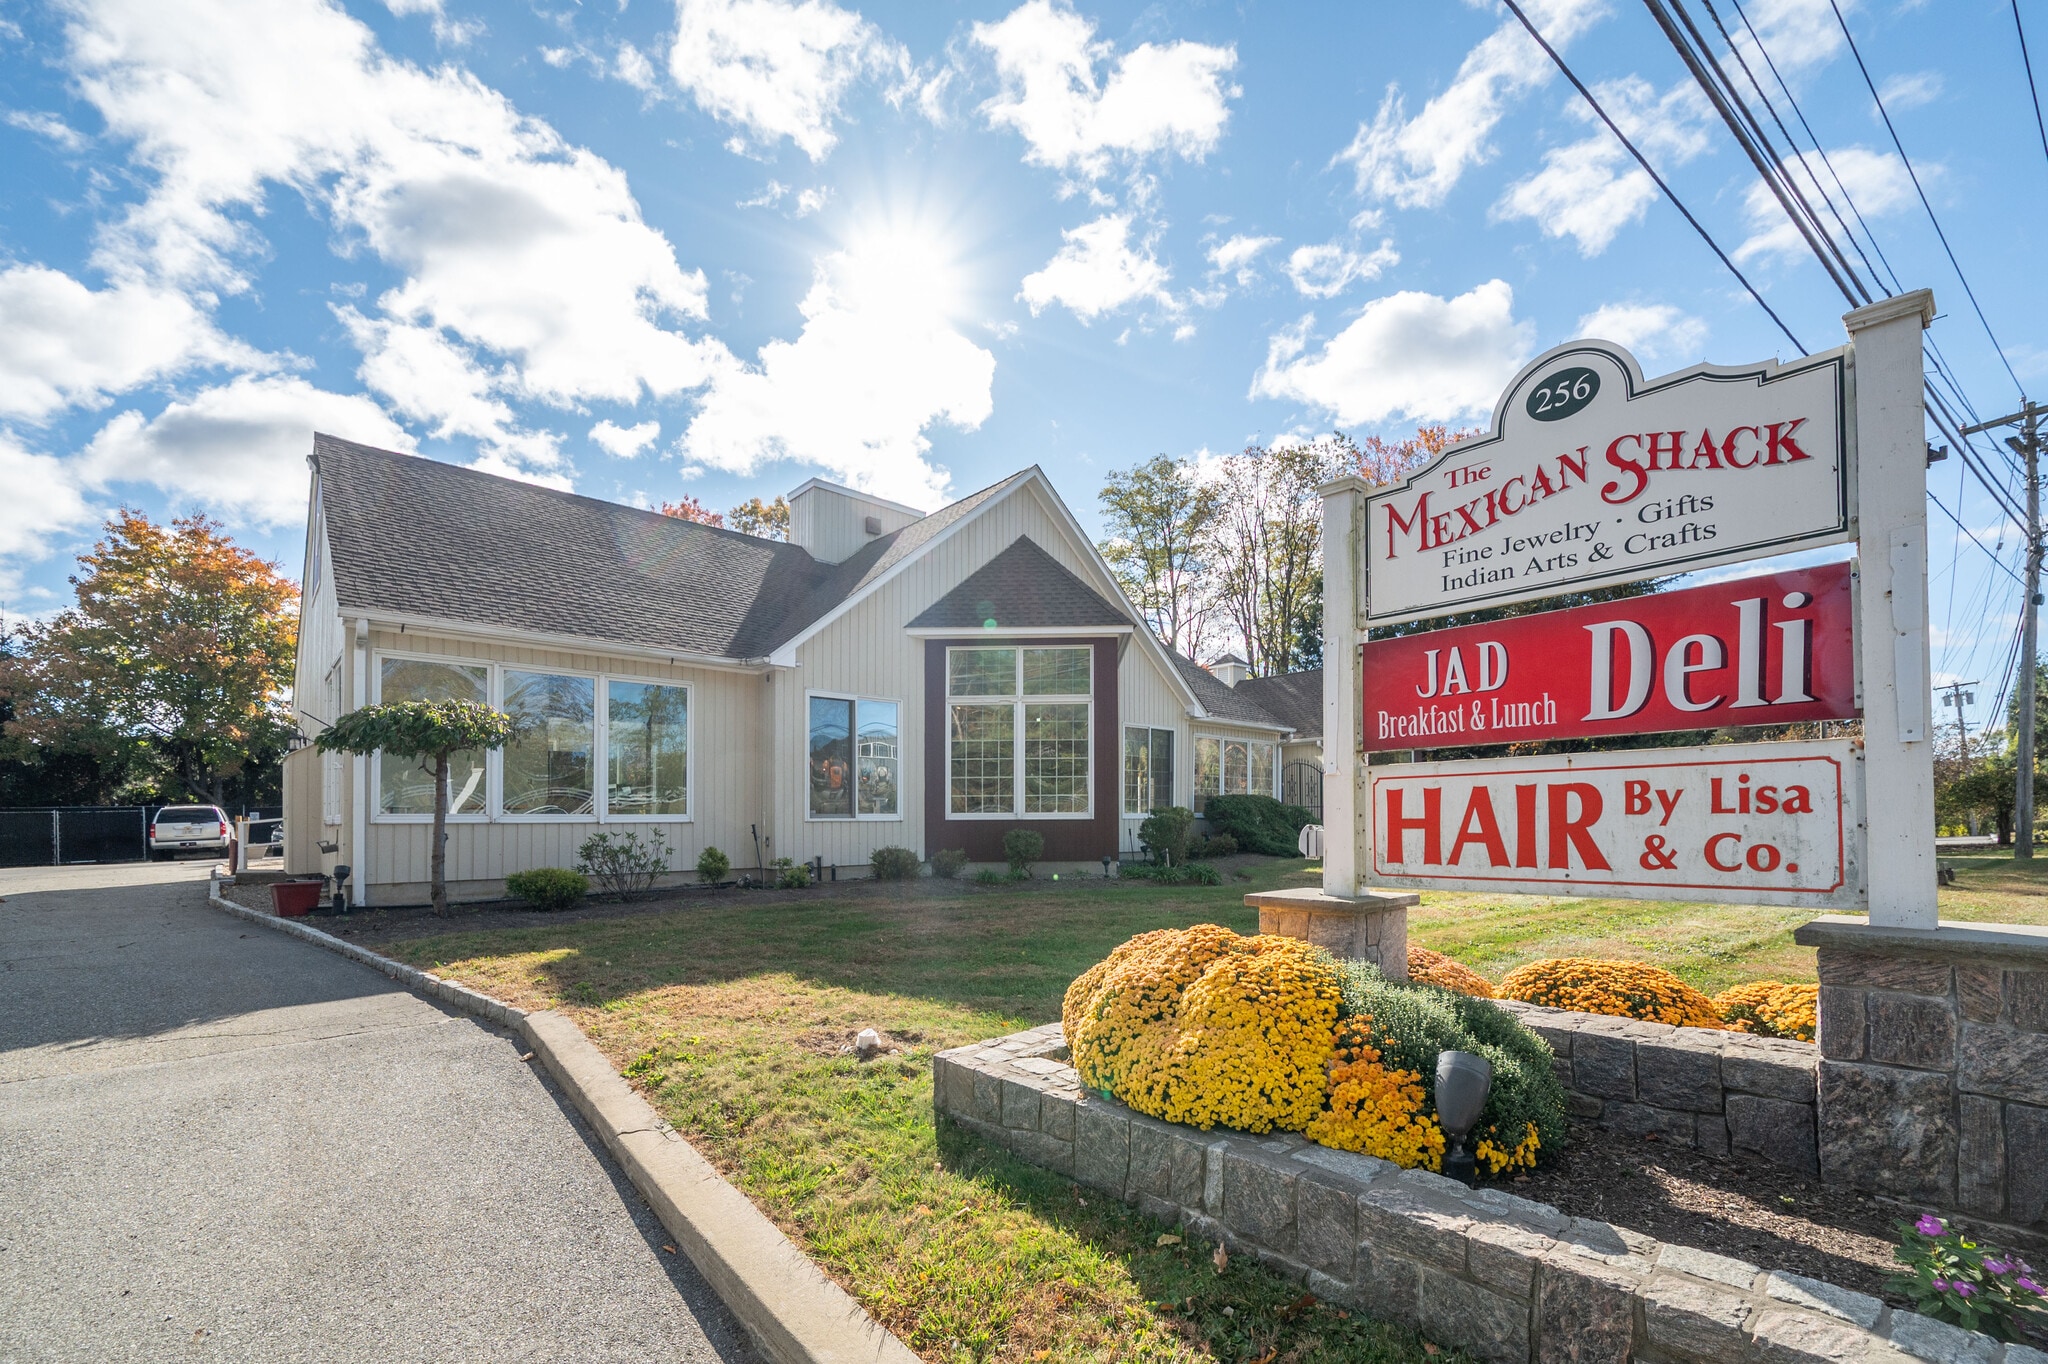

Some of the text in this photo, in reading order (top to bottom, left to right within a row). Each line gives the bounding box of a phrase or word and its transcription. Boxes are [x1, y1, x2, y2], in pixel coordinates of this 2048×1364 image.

[1535, 372, 1592, 413] 256
[1382, 417, 1812, 560] MEXICAN SHACK
[1444, 463, 1491, 489] The
[1441, 521, 1718, 592] Indian Arts & Crafts
[1443, 494, 1714, 568] Fine Jewelry Gifts
[1416, 641, 1508, 699] JAD
[1581, 591, 1816, 722] Deli
[1378, 692, 1558, 740] Breakfast & Lunch
[1386, 781, 1612, 871] HAIR
[1624, 774, 1813, 827] By Lisa
[1639, 832, 1799, 873] & Co.
